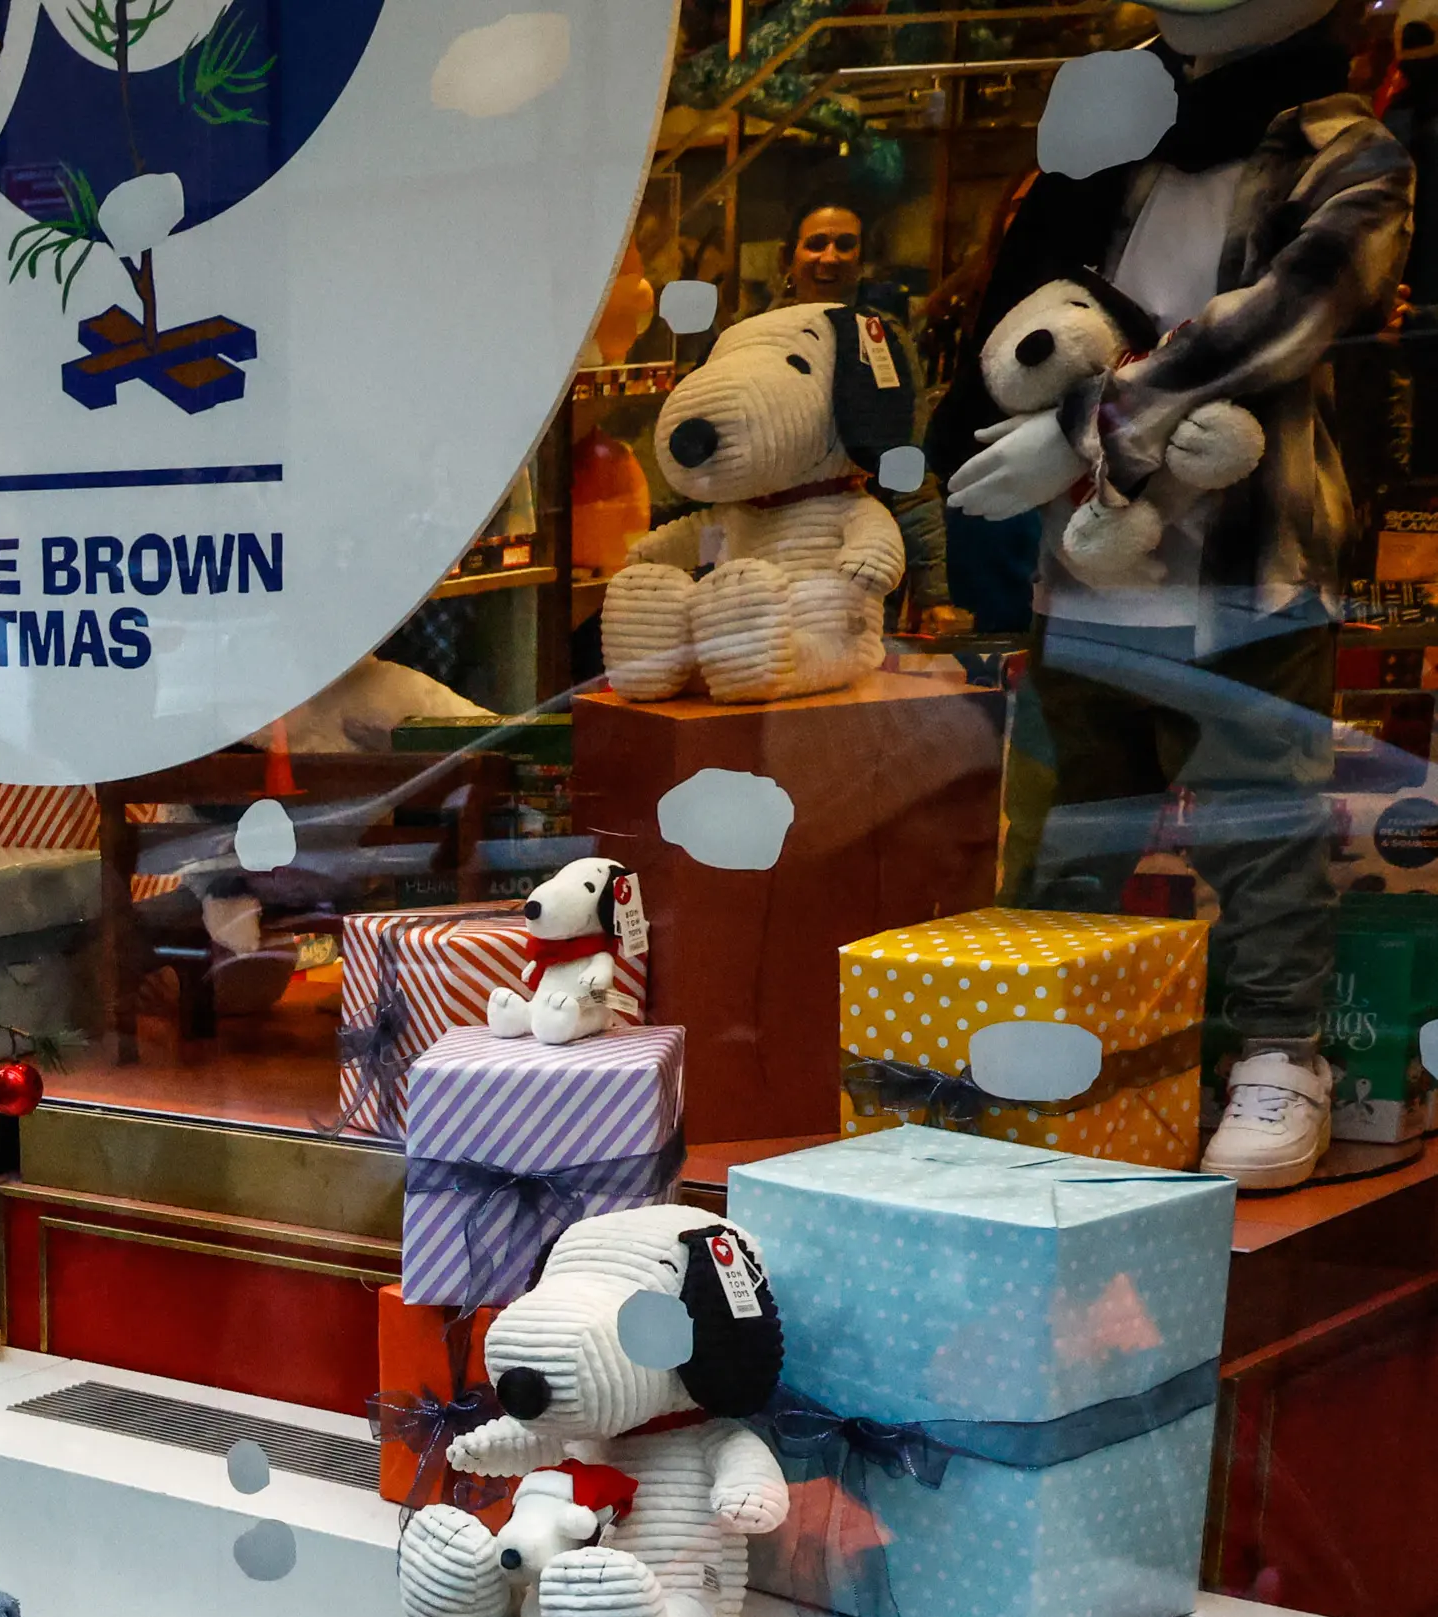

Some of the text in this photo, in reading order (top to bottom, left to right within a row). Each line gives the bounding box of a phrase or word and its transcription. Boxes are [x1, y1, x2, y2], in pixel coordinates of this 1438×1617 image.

[41, 532, 284, 596] BROWN
[725, 1270, 743, 1279] BON
[733, 1290, 750, 1298] TOYS
